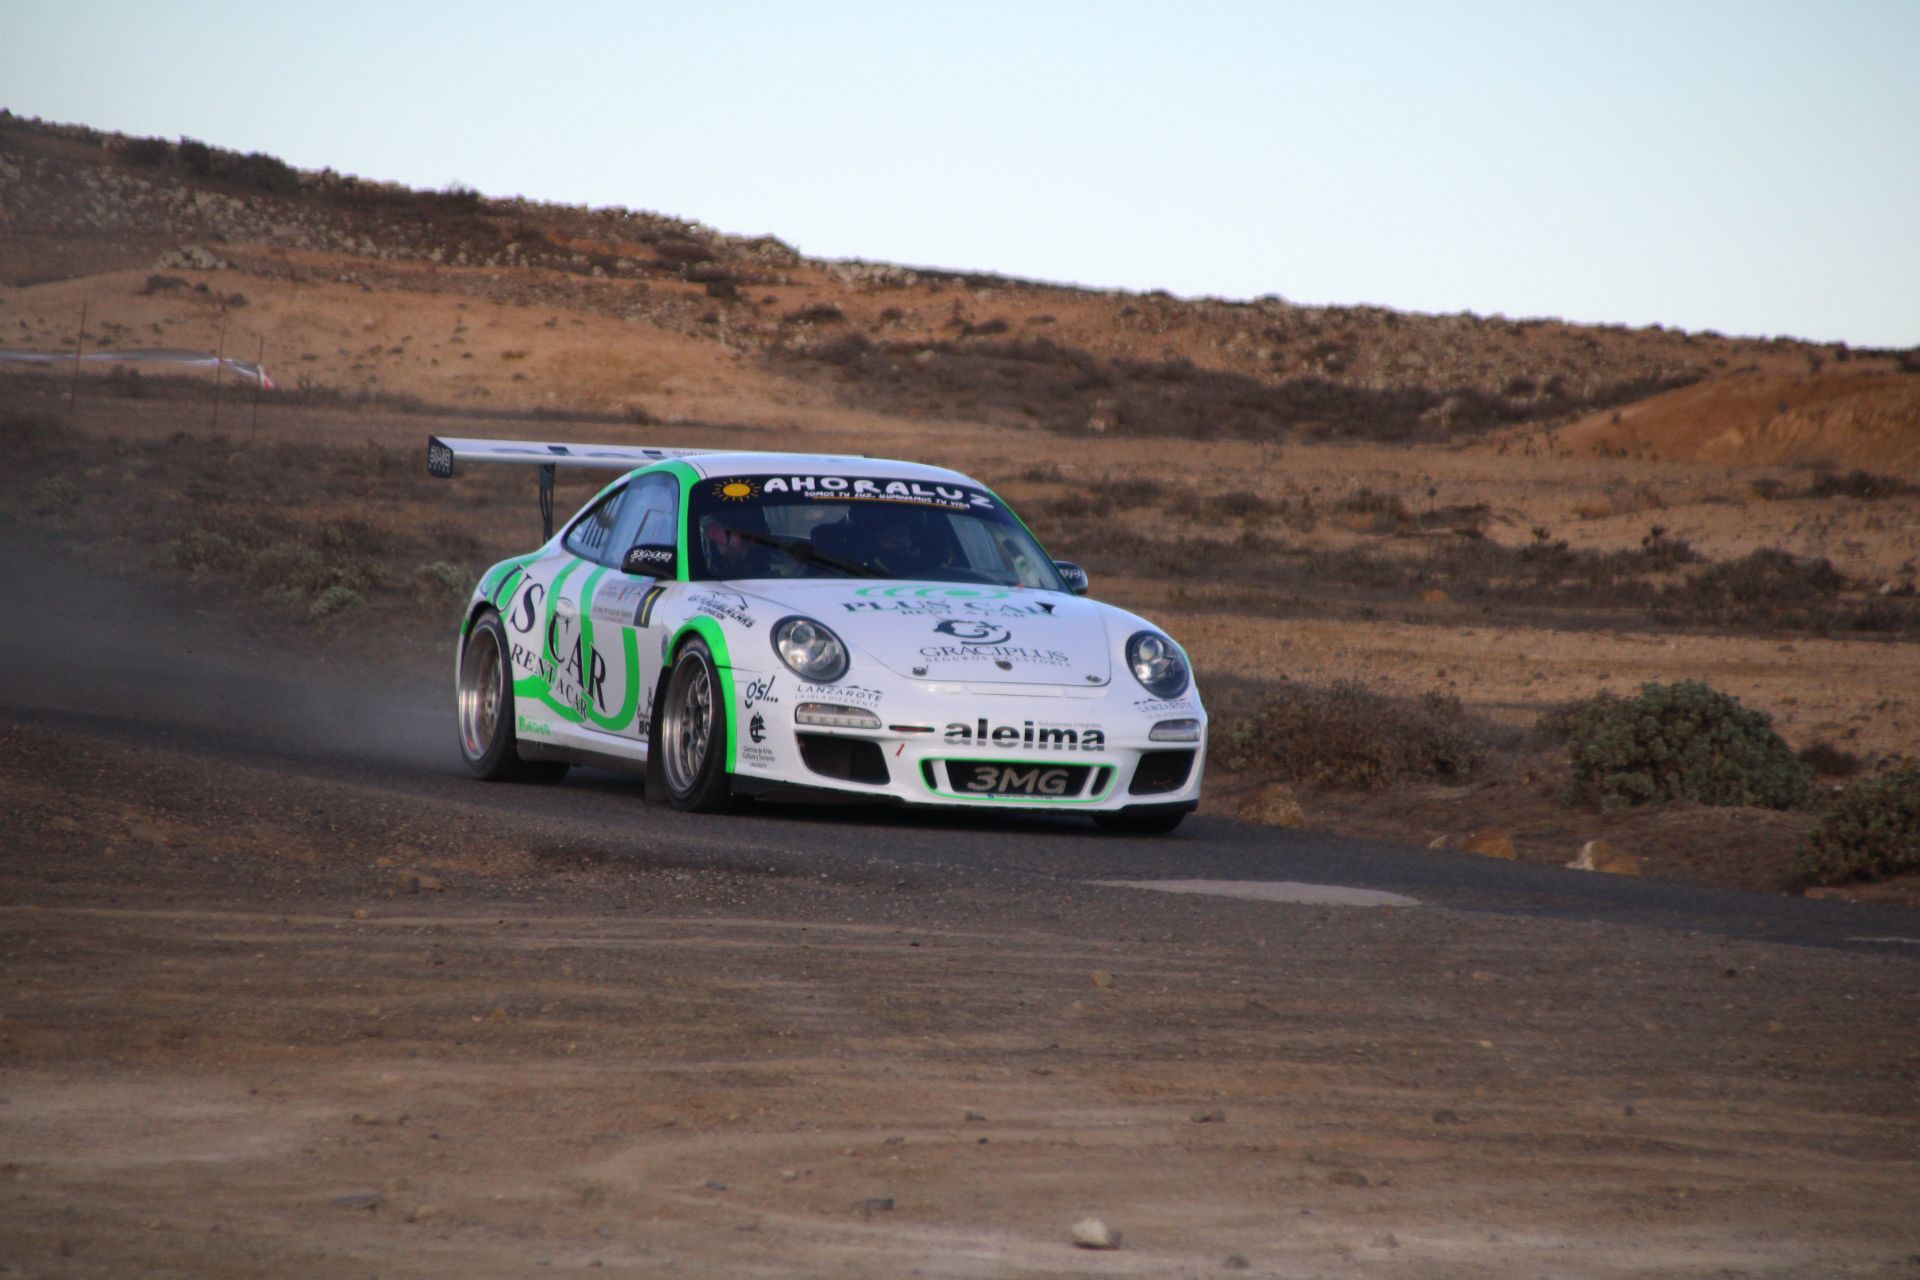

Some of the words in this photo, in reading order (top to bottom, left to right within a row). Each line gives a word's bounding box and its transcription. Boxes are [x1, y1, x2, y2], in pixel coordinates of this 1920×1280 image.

[763, 476, 994, 509] AHORALUZ
[950, 500, 970, 509] VIDA
[842, 600, 952, 612] PLUS
[919, 646, 1069, 662] GRACIPLUS
[511, 642, 557, 684] RENT
[565, 684, 587, 720] CAR
[797, 685, 883, 702] LANZAROTE
[943, 718, 1105, 751] aleima
[967, 766, 1070, 795] 3MG
